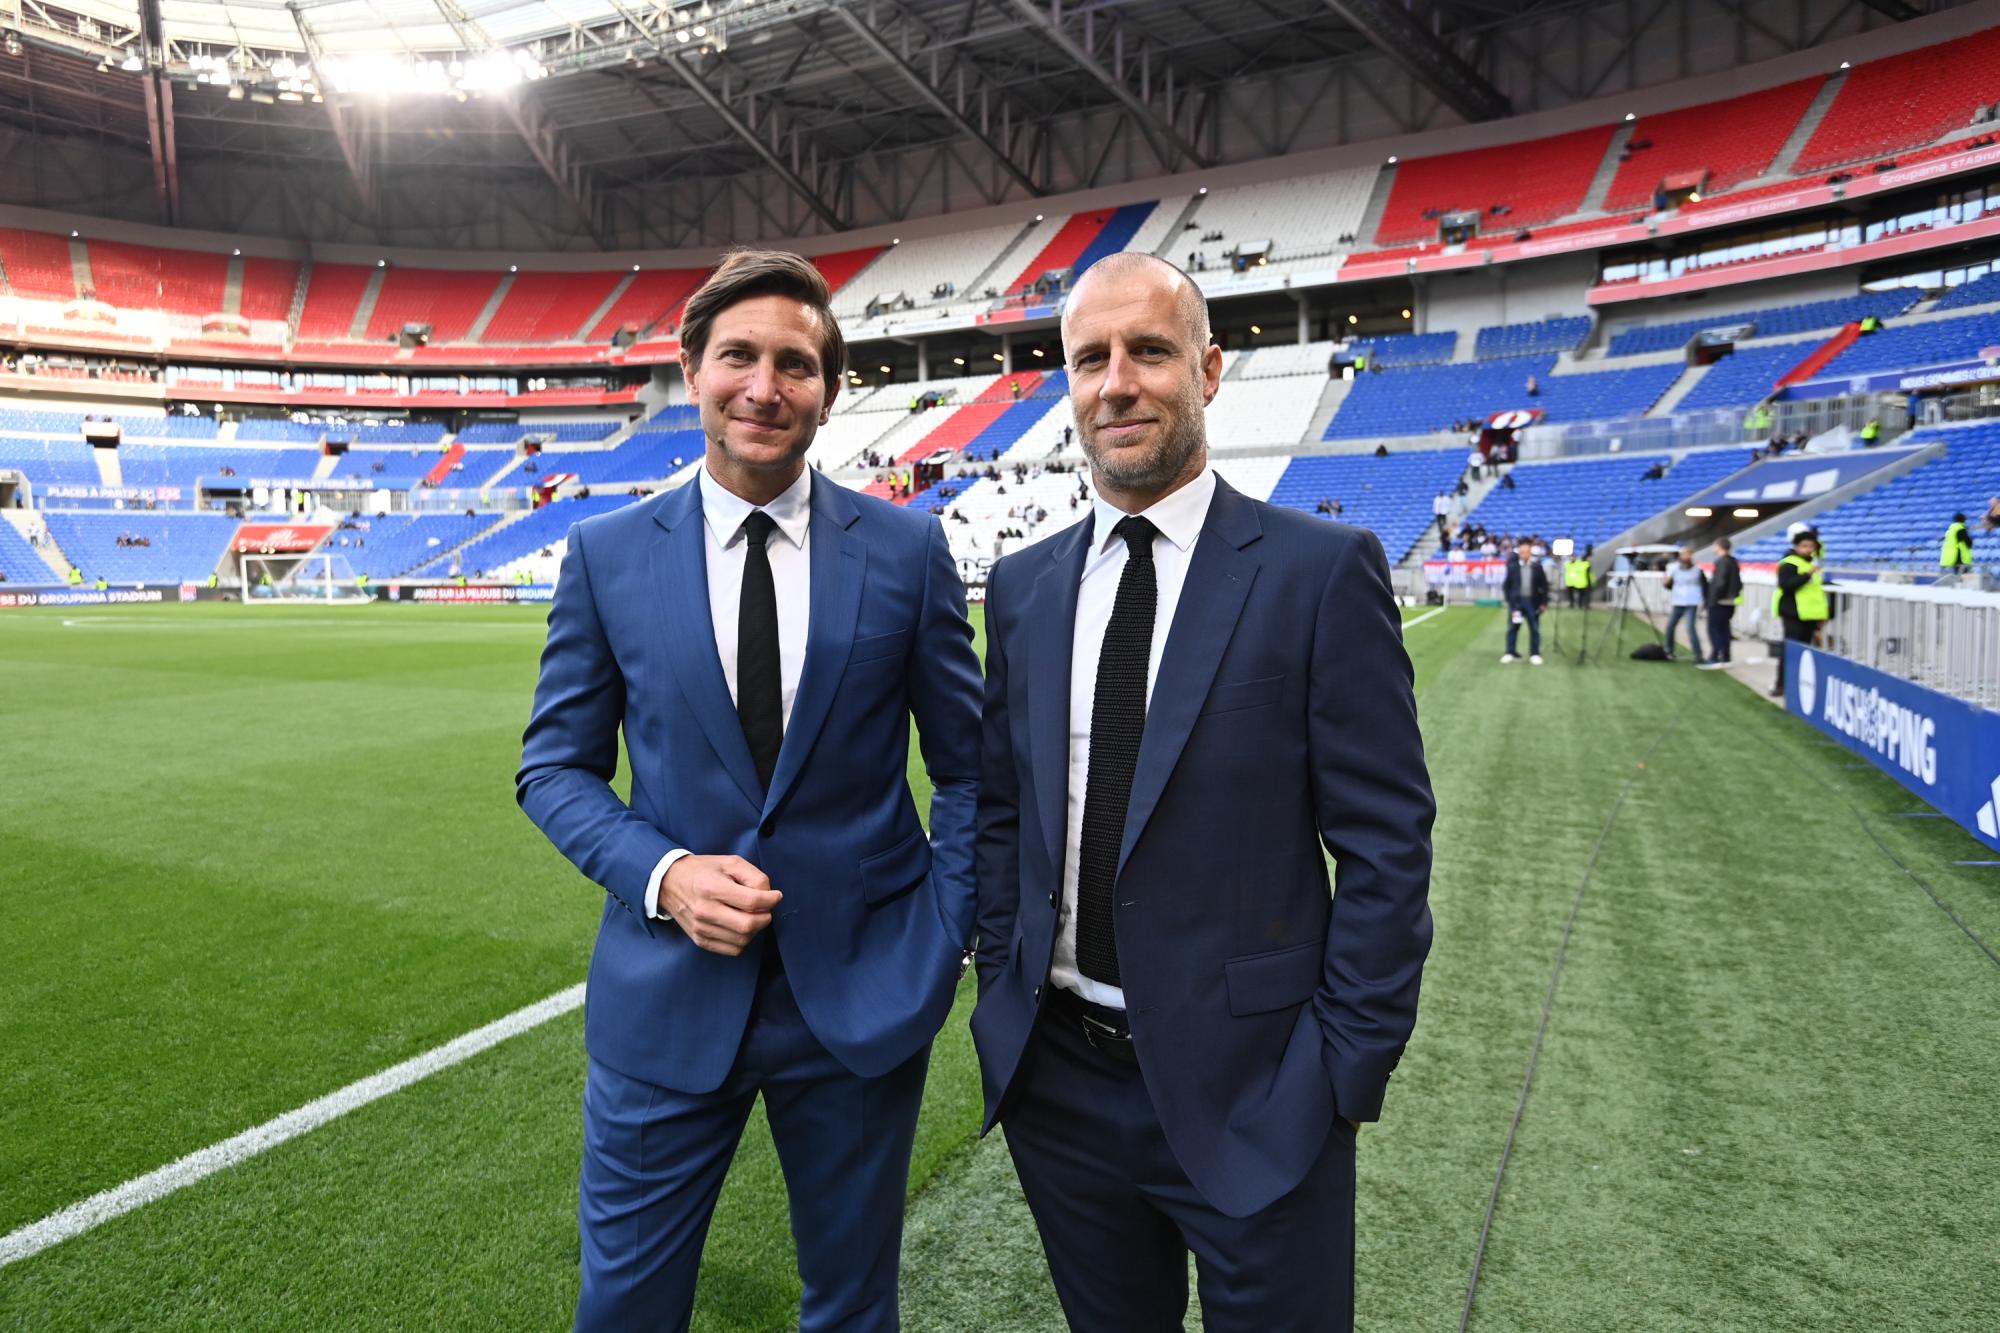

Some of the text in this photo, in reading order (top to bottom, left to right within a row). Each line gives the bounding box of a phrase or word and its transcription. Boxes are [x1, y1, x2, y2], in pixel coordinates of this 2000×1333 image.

[17, 593, 37, 606] DU
[38, 591, 106, 606] GROUPAMA
[107, 590, 162, 603] STADIUM
[503, 588, 515, 600] DU
